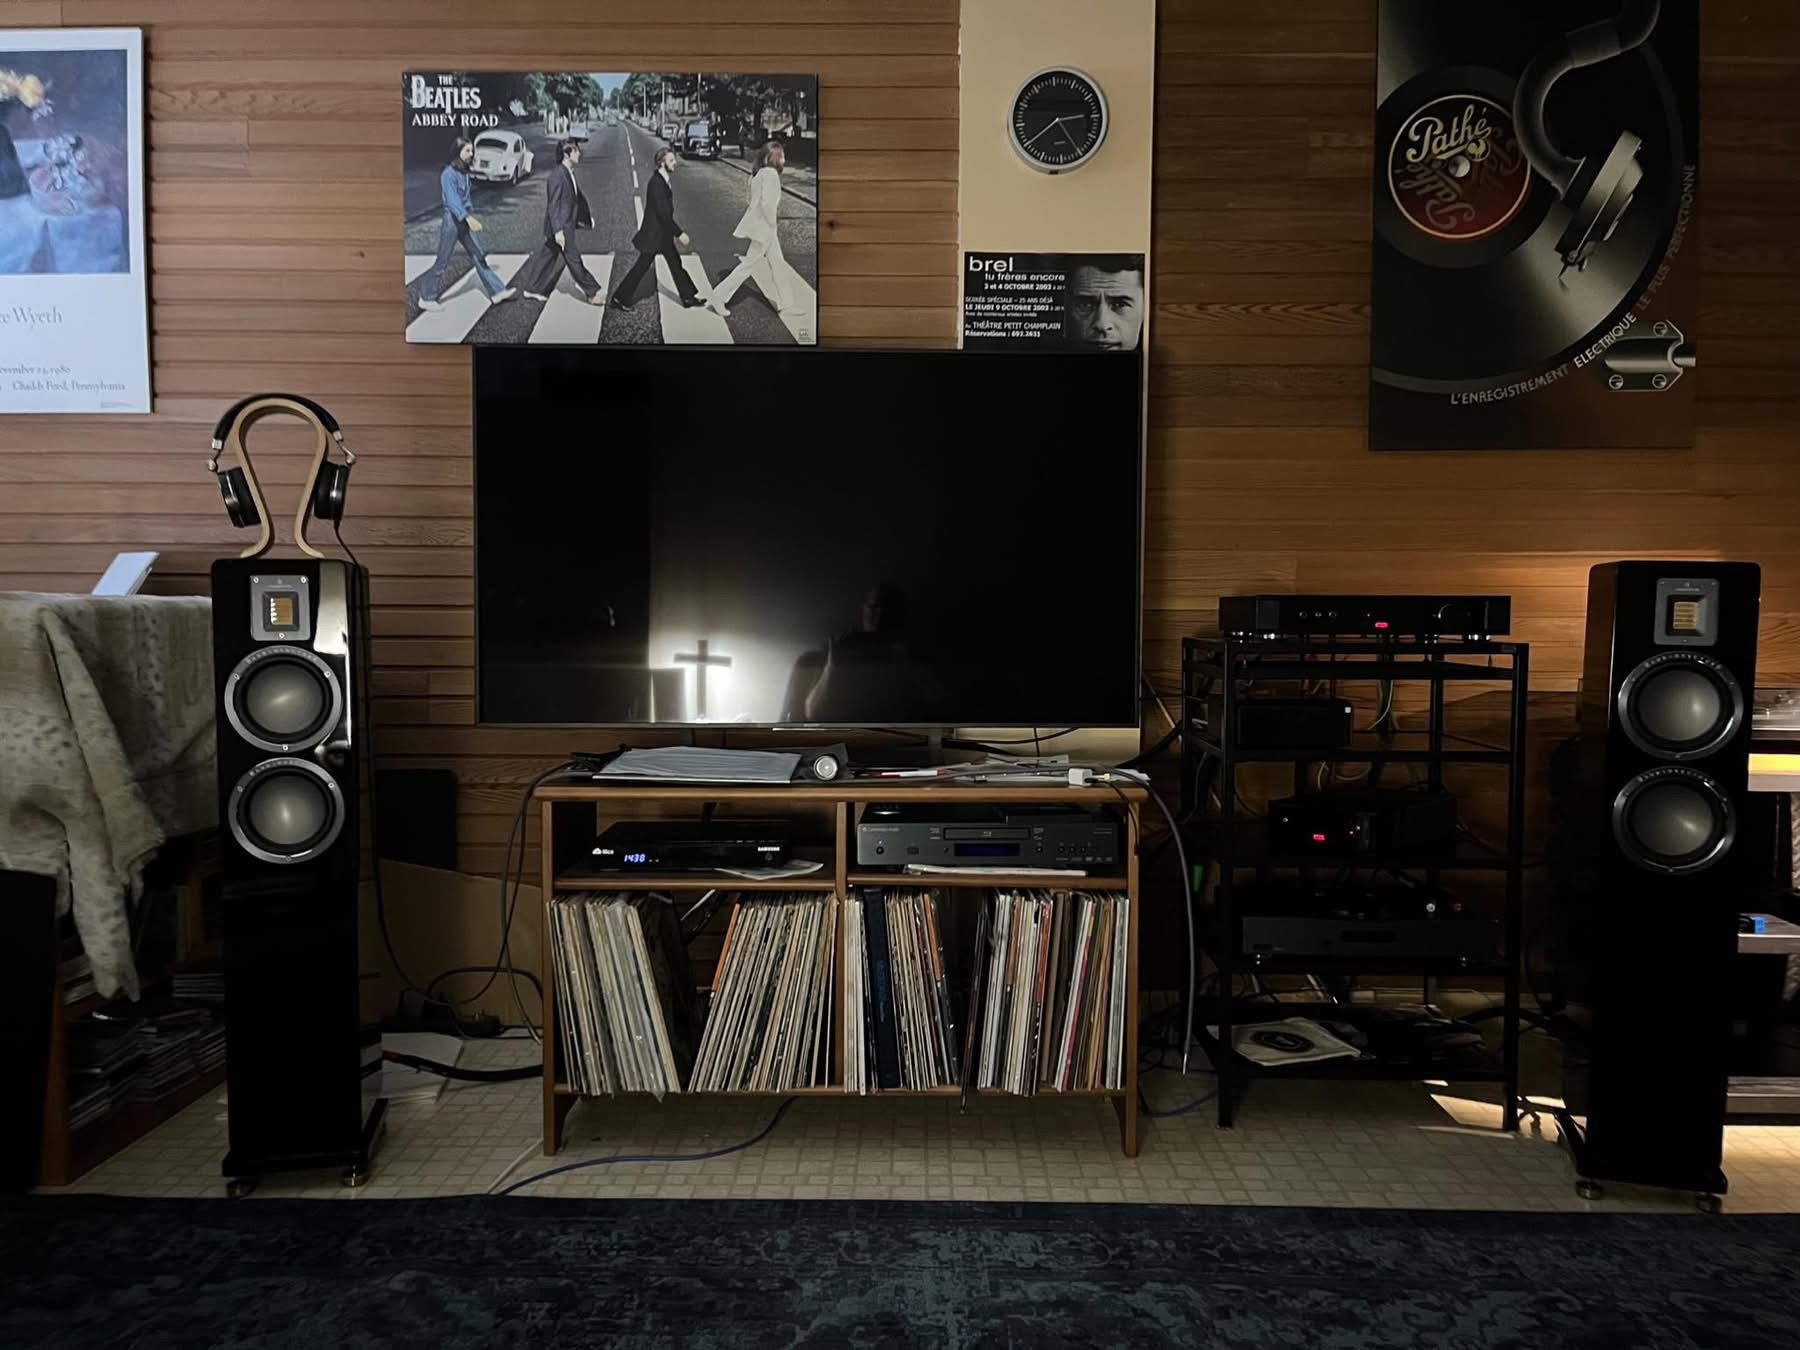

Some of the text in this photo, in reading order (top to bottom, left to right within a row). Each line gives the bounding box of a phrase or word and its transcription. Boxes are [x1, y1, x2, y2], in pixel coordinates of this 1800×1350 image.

[438, 75, 453, 86] THE
[410, 75, 482, 114] BEATLES
[412, 113, 499, 128] ABBEY ROAD
[1406, 104, 1492, 163] Pathé
[969, 256, 1014, 272] brel
[1029, 273, 1065, 281] encore
[1573, 312, 1637, 368] ELECTRIQUE
[1450, 364, 1571, 405] L'ENREGISTREMENT
